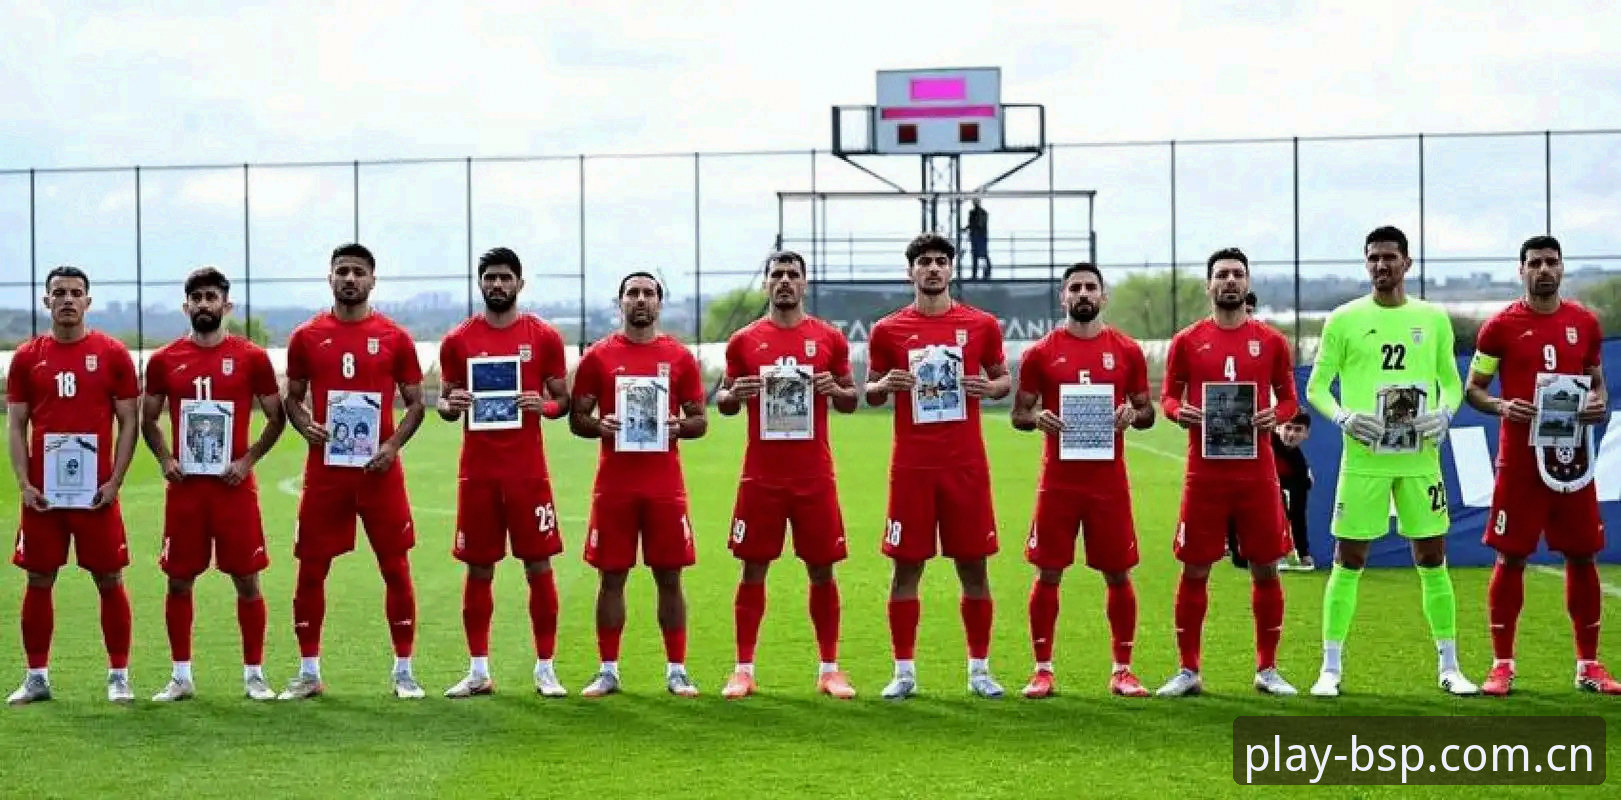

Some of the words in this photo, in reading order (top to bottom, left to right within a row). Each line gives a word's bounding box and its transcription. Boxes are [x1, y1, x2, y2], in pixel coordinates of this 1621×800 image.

[342, 352, 355, 379] 8
[1224, 356, 1236, 381] 4
[1381, 344, 1406, 370] 22
[1543, 344, 1557, 371] 9
[55, 371, 77, 397] 18
[193, 376, 212, 400] 11
[1494, 510, 1507, 535] 9
